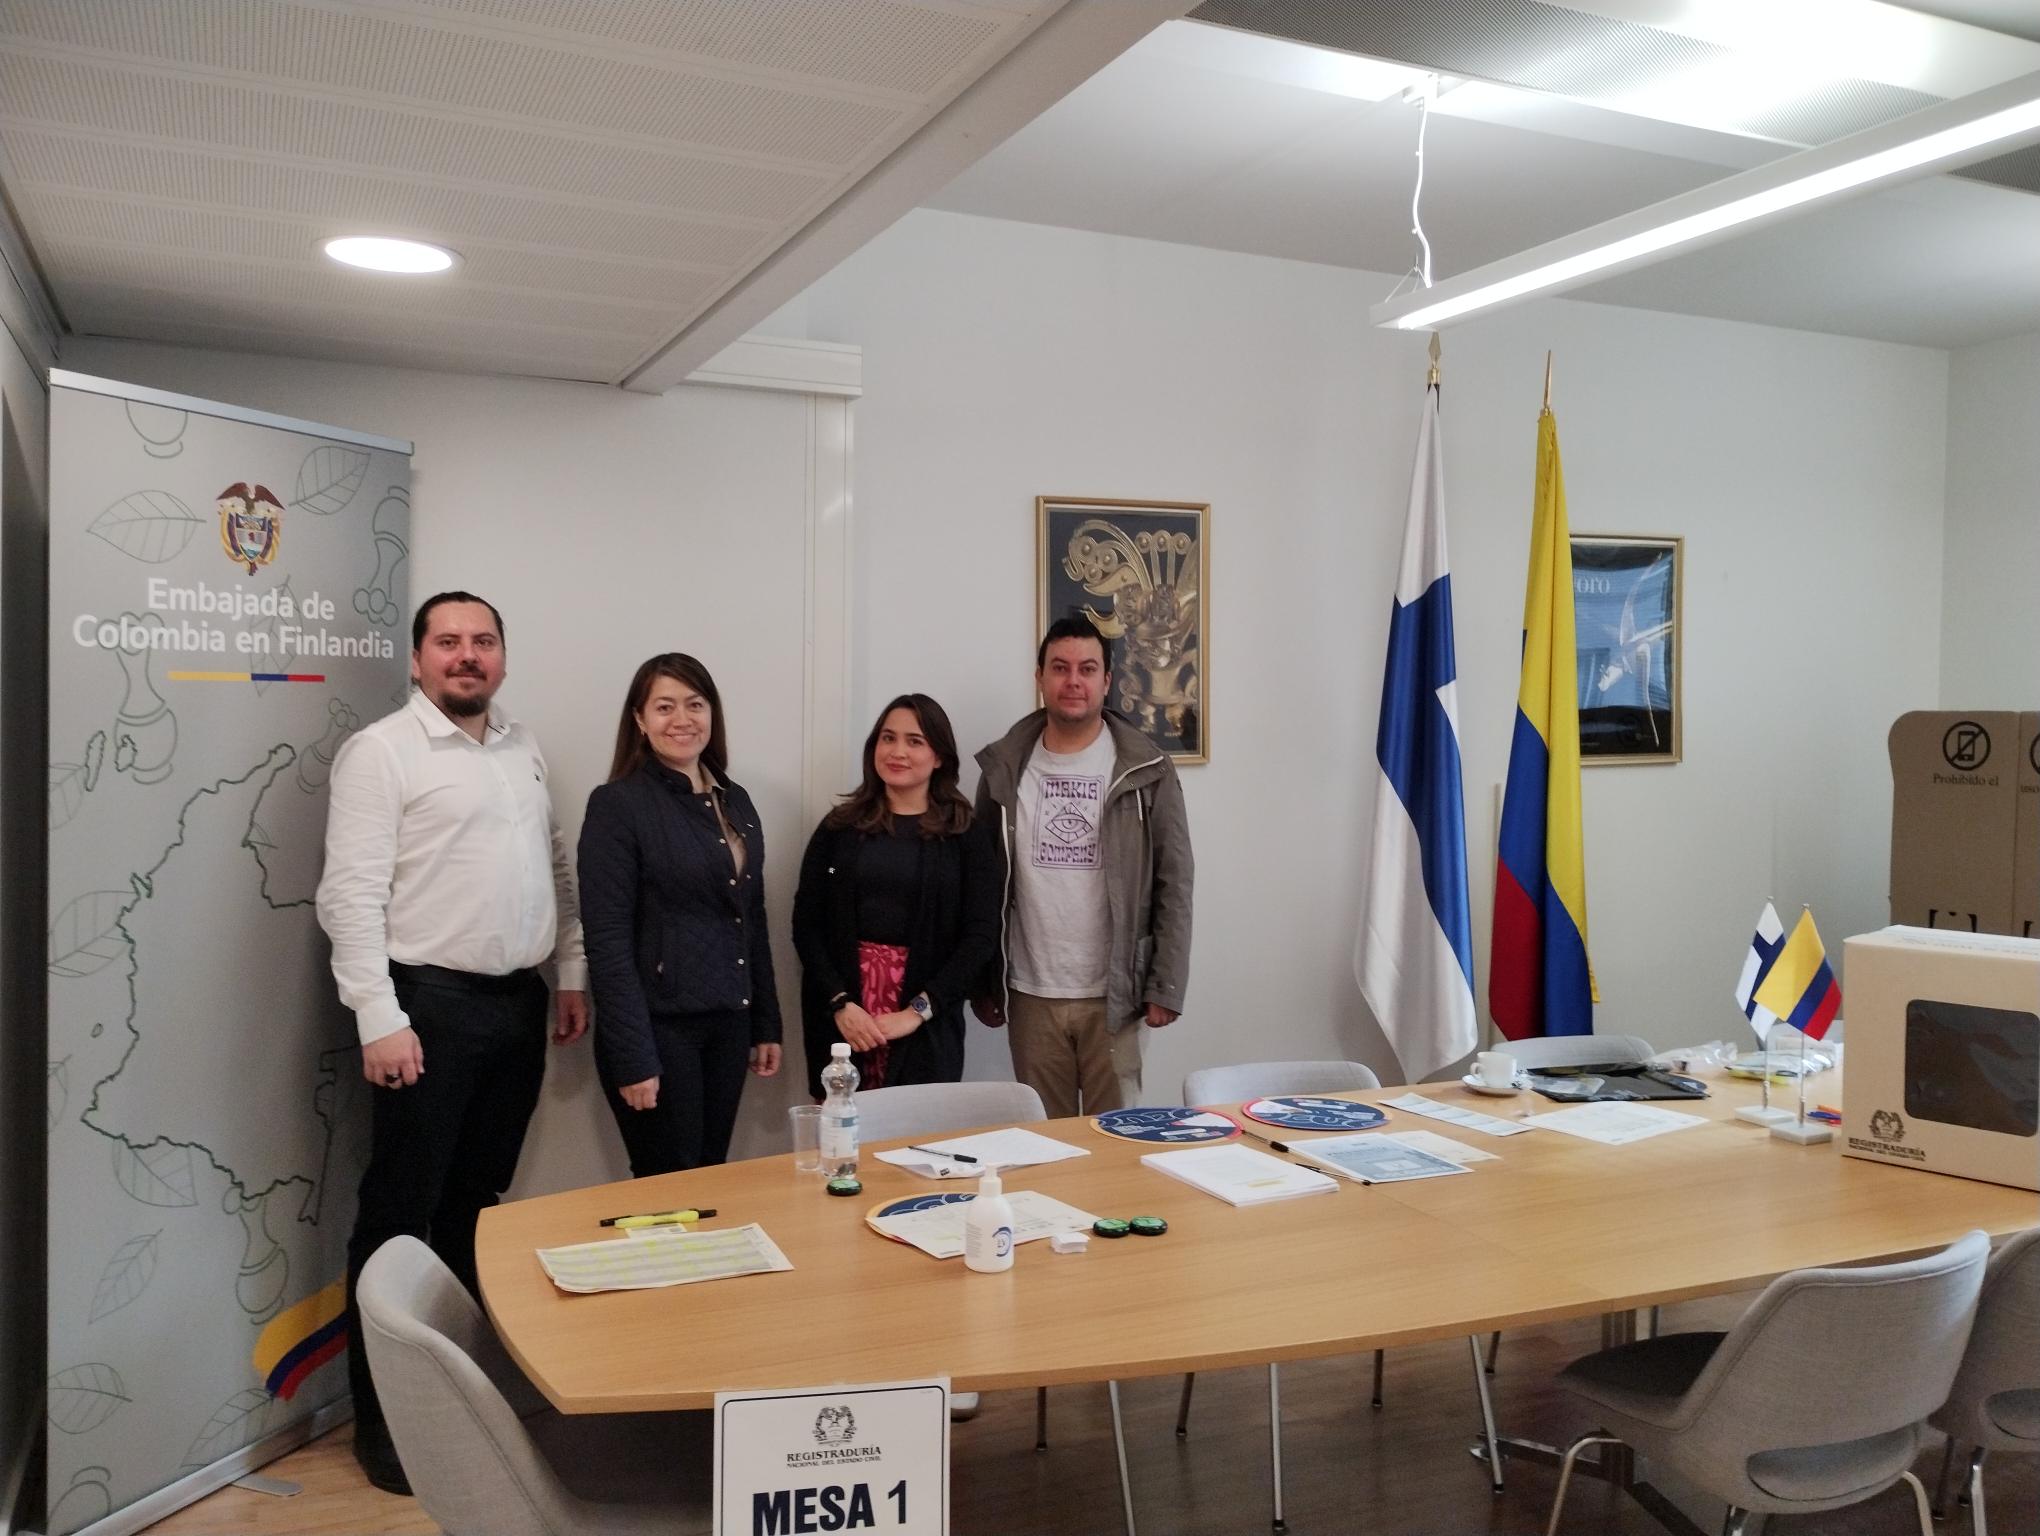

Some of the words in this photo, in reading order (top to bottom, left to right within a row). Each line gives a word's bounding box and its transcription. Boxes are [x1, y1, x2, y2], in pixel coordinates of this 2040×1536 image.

[147, 577, 294, 620] Embajada
[302, 591, 335, 621] de
[73, 615, 226, 654] Colombia
[235, 629, 270, 654] en
[279, 626, 394, 659] Finlandia
[1933, 773, 1986, 786] Prohibido
[1988, 775, 1999, 786] el
[786, 1444, 881, 1462] REGISTRADURÍA
[753, 1483, 875, 1536] MESA
[888, 1480, 906, 1524] 1
